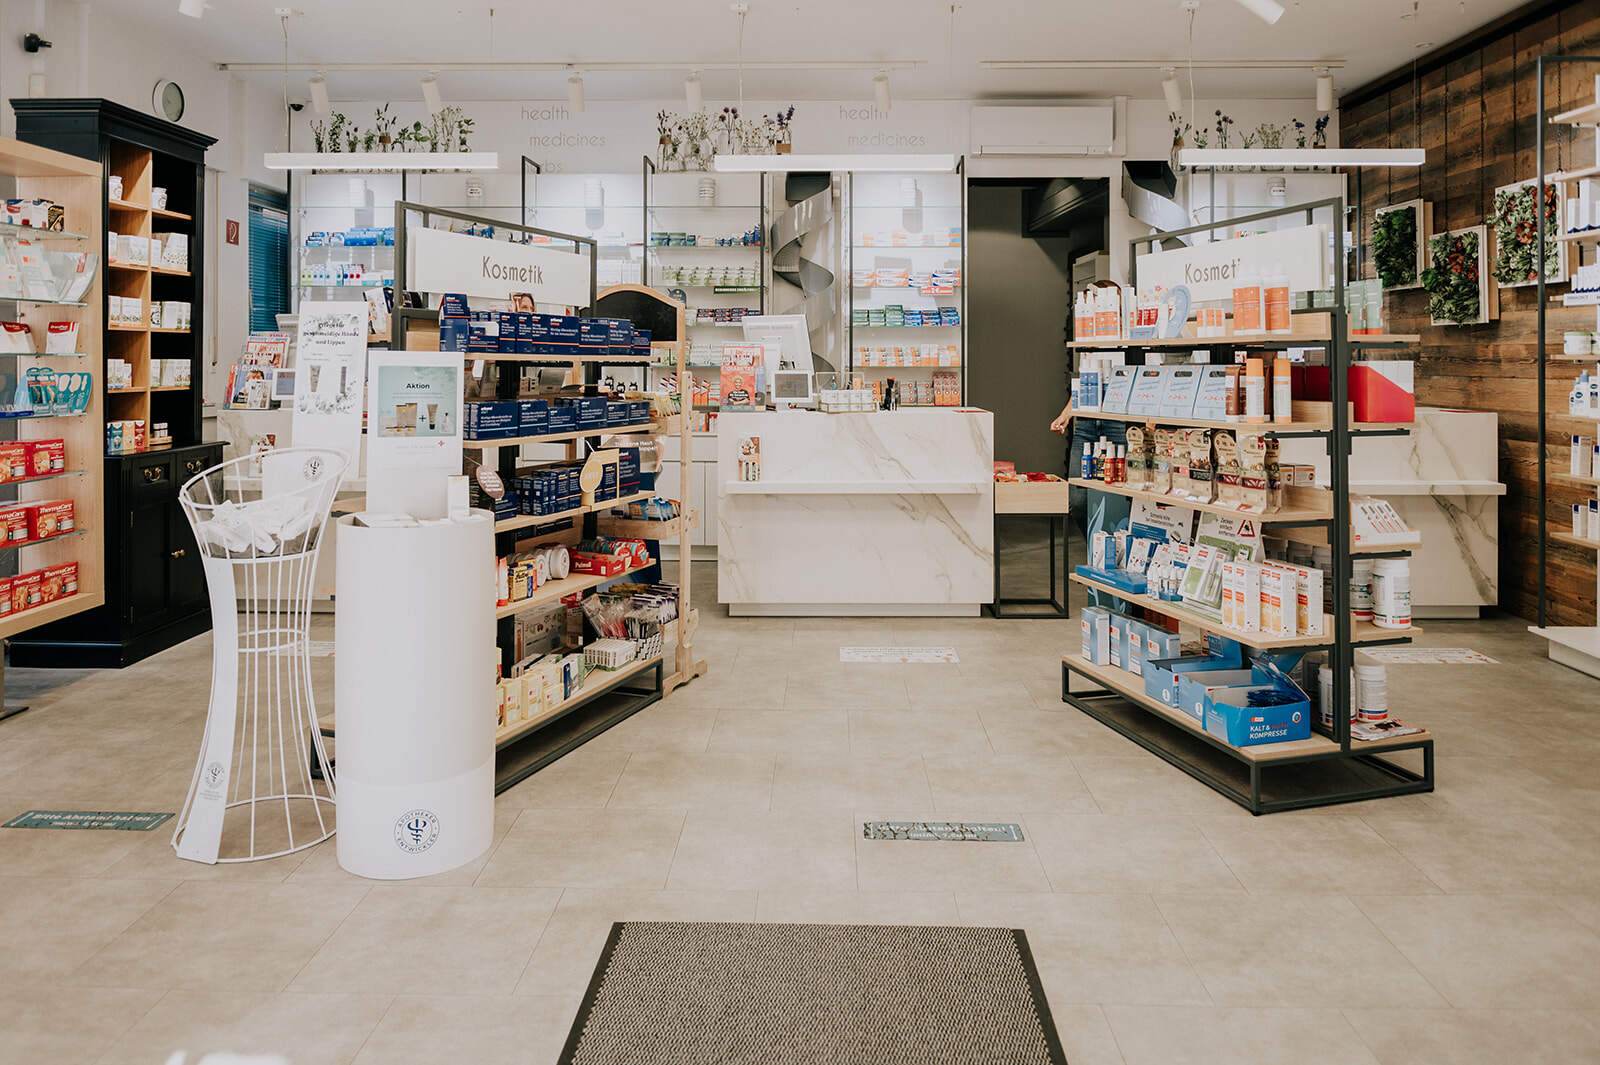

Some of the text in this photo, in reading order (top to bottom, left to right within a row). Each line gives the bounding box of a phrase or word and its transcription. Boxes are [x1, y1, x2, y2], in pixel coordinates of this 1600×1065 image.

[521, 105, 569, 120] health
[529, 132, 608, 146] medicines
[848, 132, 926, 146] medicines
[482, 256, 544, 285] Kosmetik
[1185, 257, 1241, 284] Kosmet
[1250, 729, 1288, 740] KOMPRESSE
